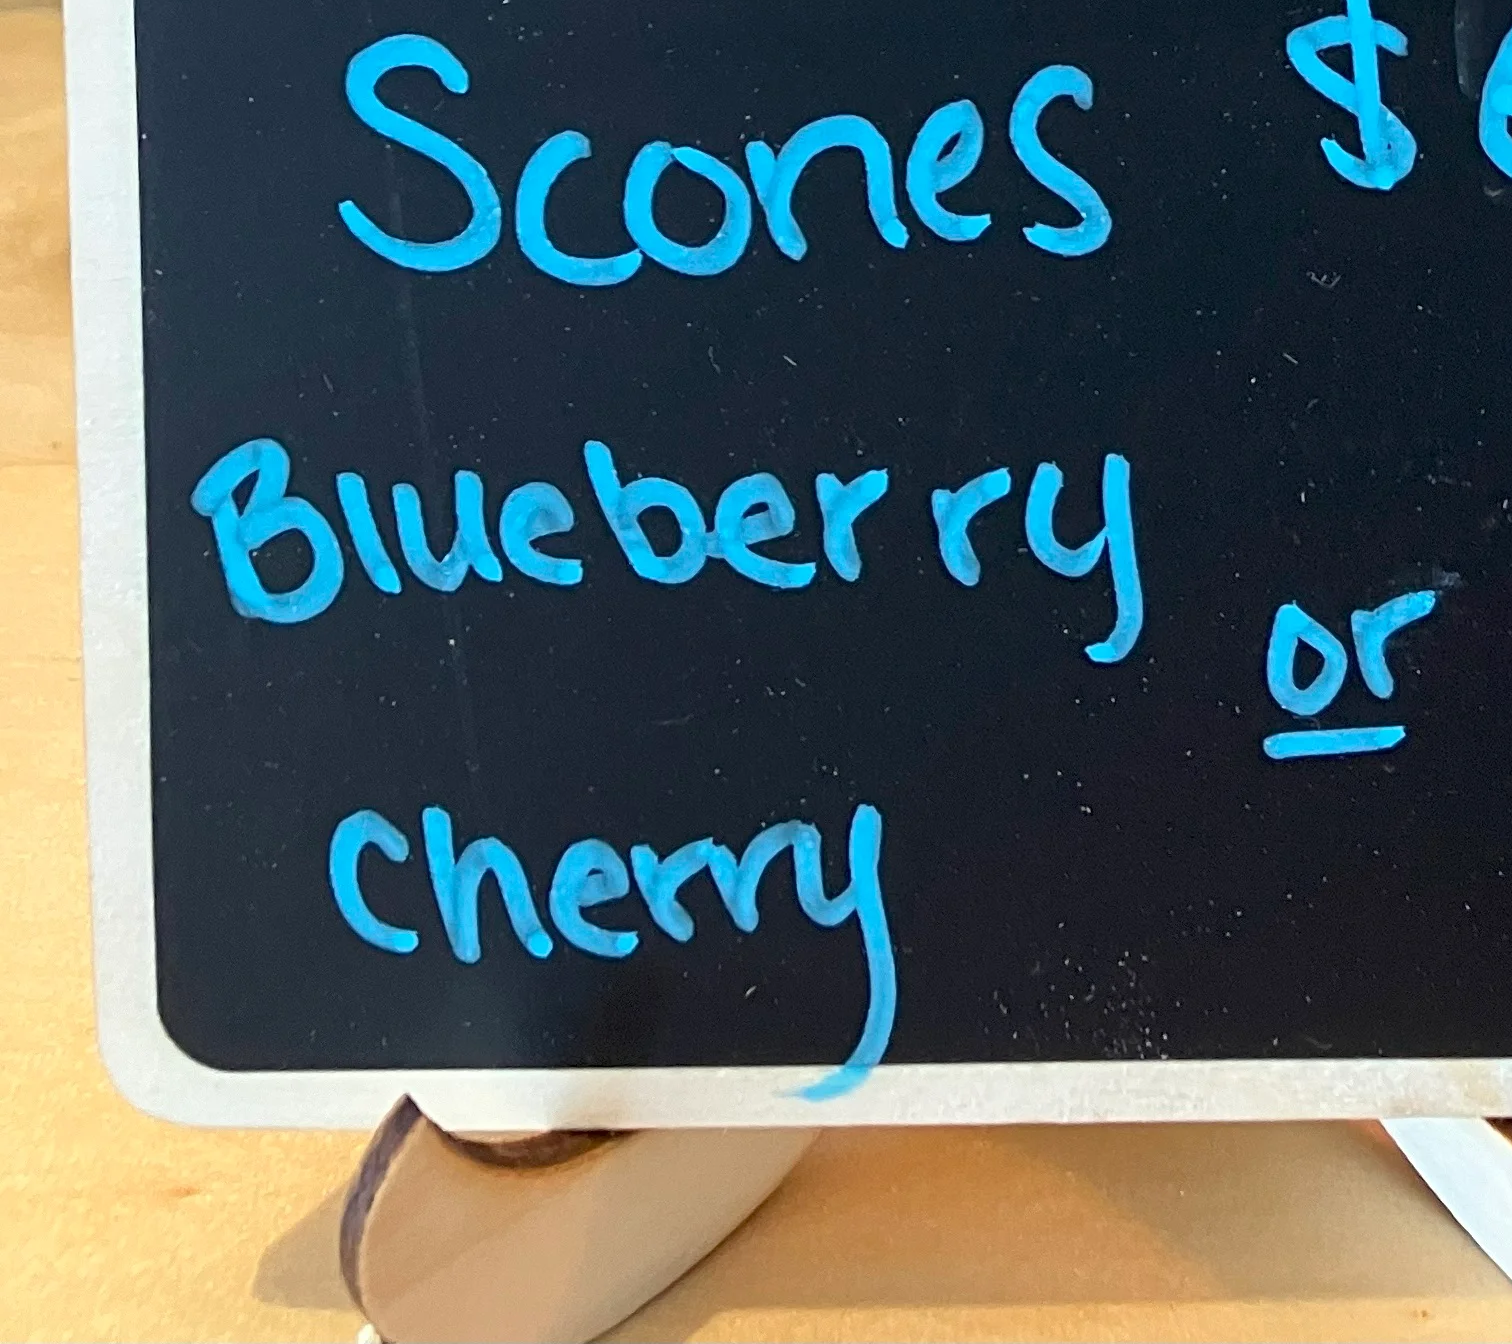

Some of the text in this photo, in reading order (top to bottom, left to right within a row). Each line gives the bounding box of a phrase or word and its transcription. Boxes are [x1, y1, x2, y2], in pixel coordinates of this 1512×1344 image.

[336, 32, 1114, 288] Scones
[189, 436, 1440, 718] Blueberry or
